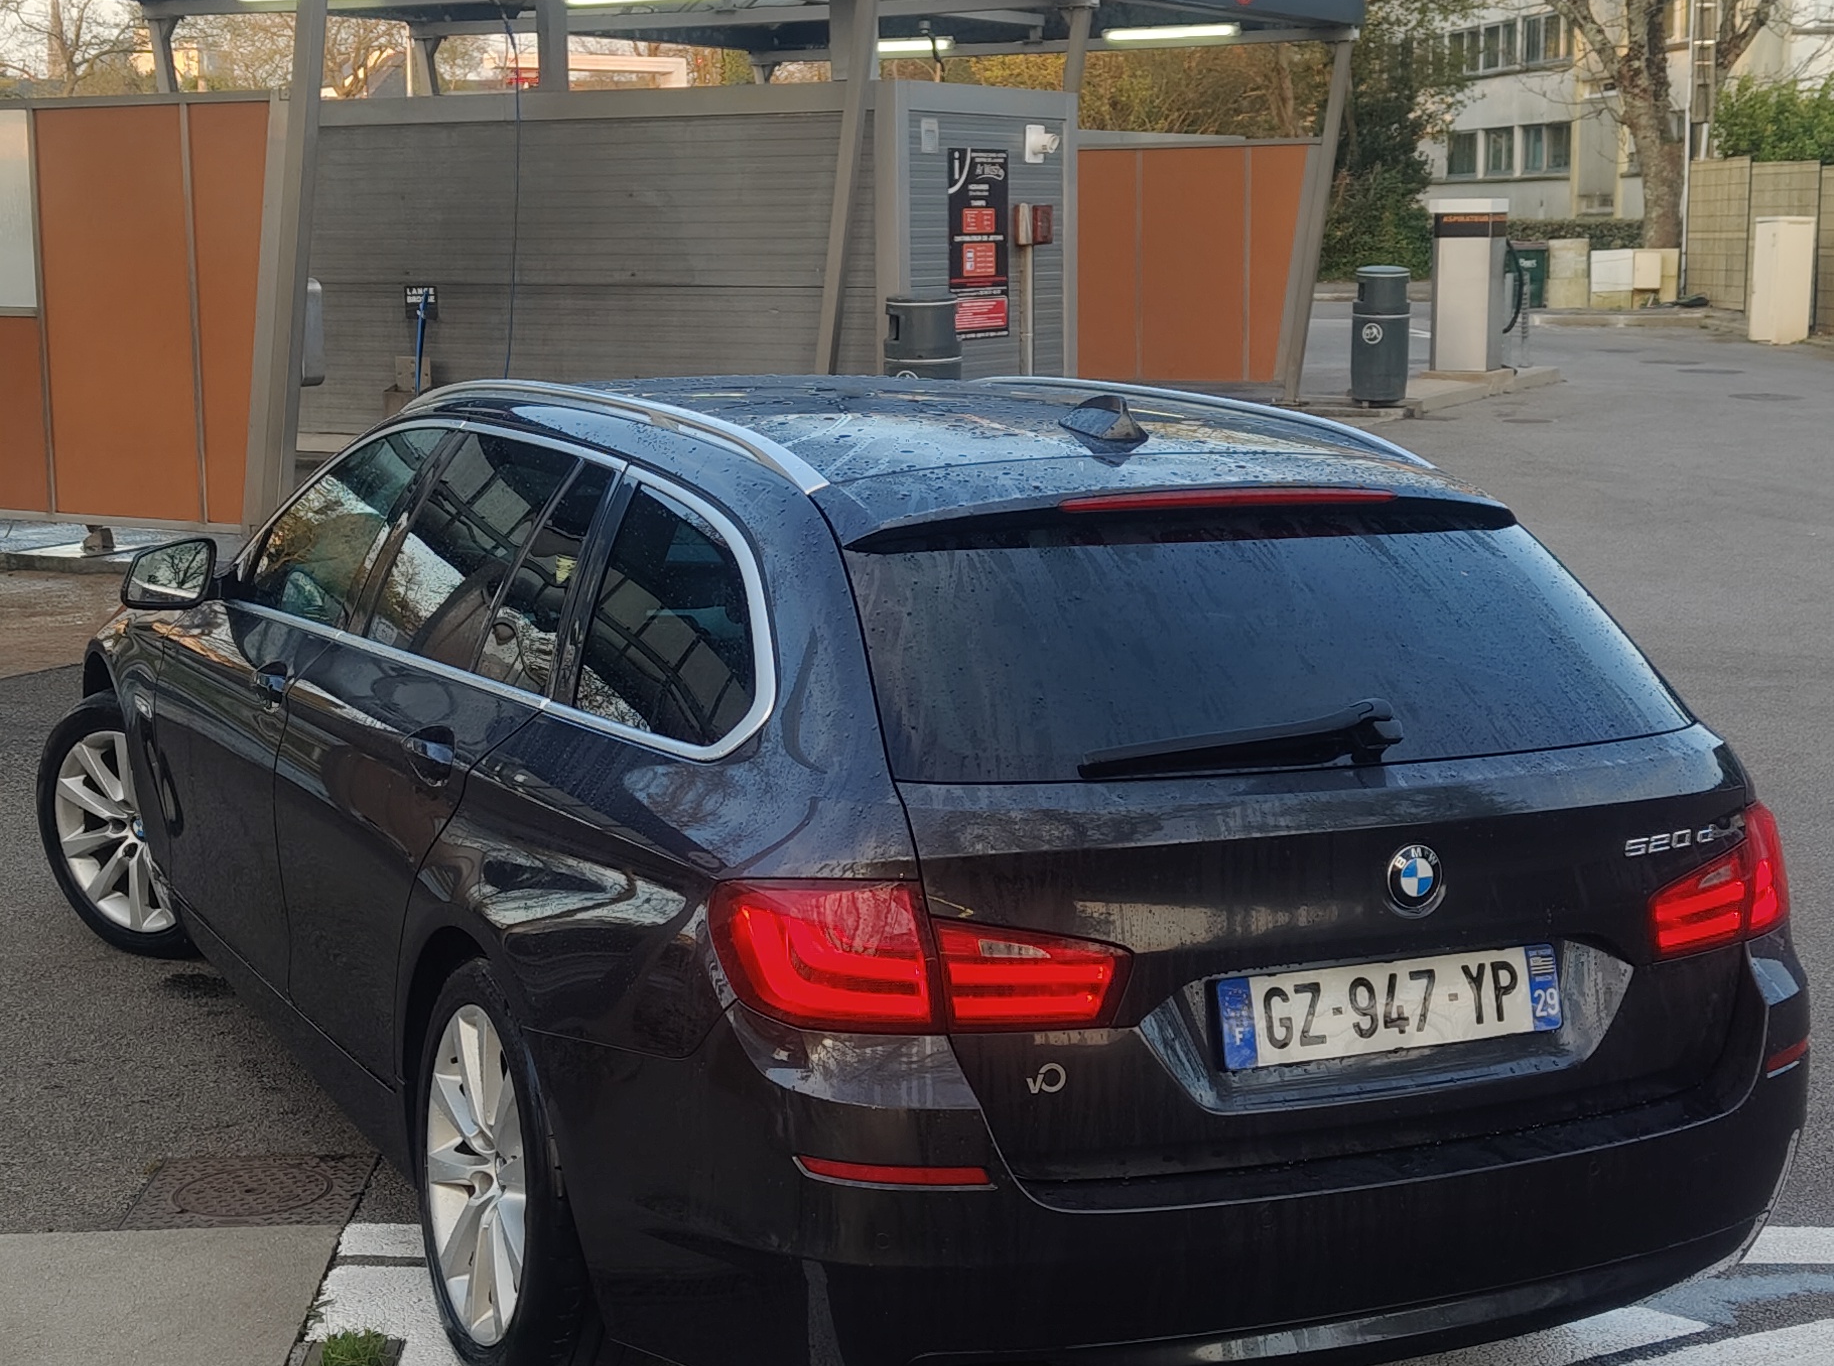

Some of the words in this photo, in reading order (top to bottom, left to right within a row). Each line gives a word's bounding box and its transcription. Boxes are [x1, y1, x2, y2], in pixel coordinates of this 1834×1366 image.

[1394, 846, 1438, 869] BMW
[1533, 987, 1560, 1018] 29
[1234, 1027, 1244, 1046] F
